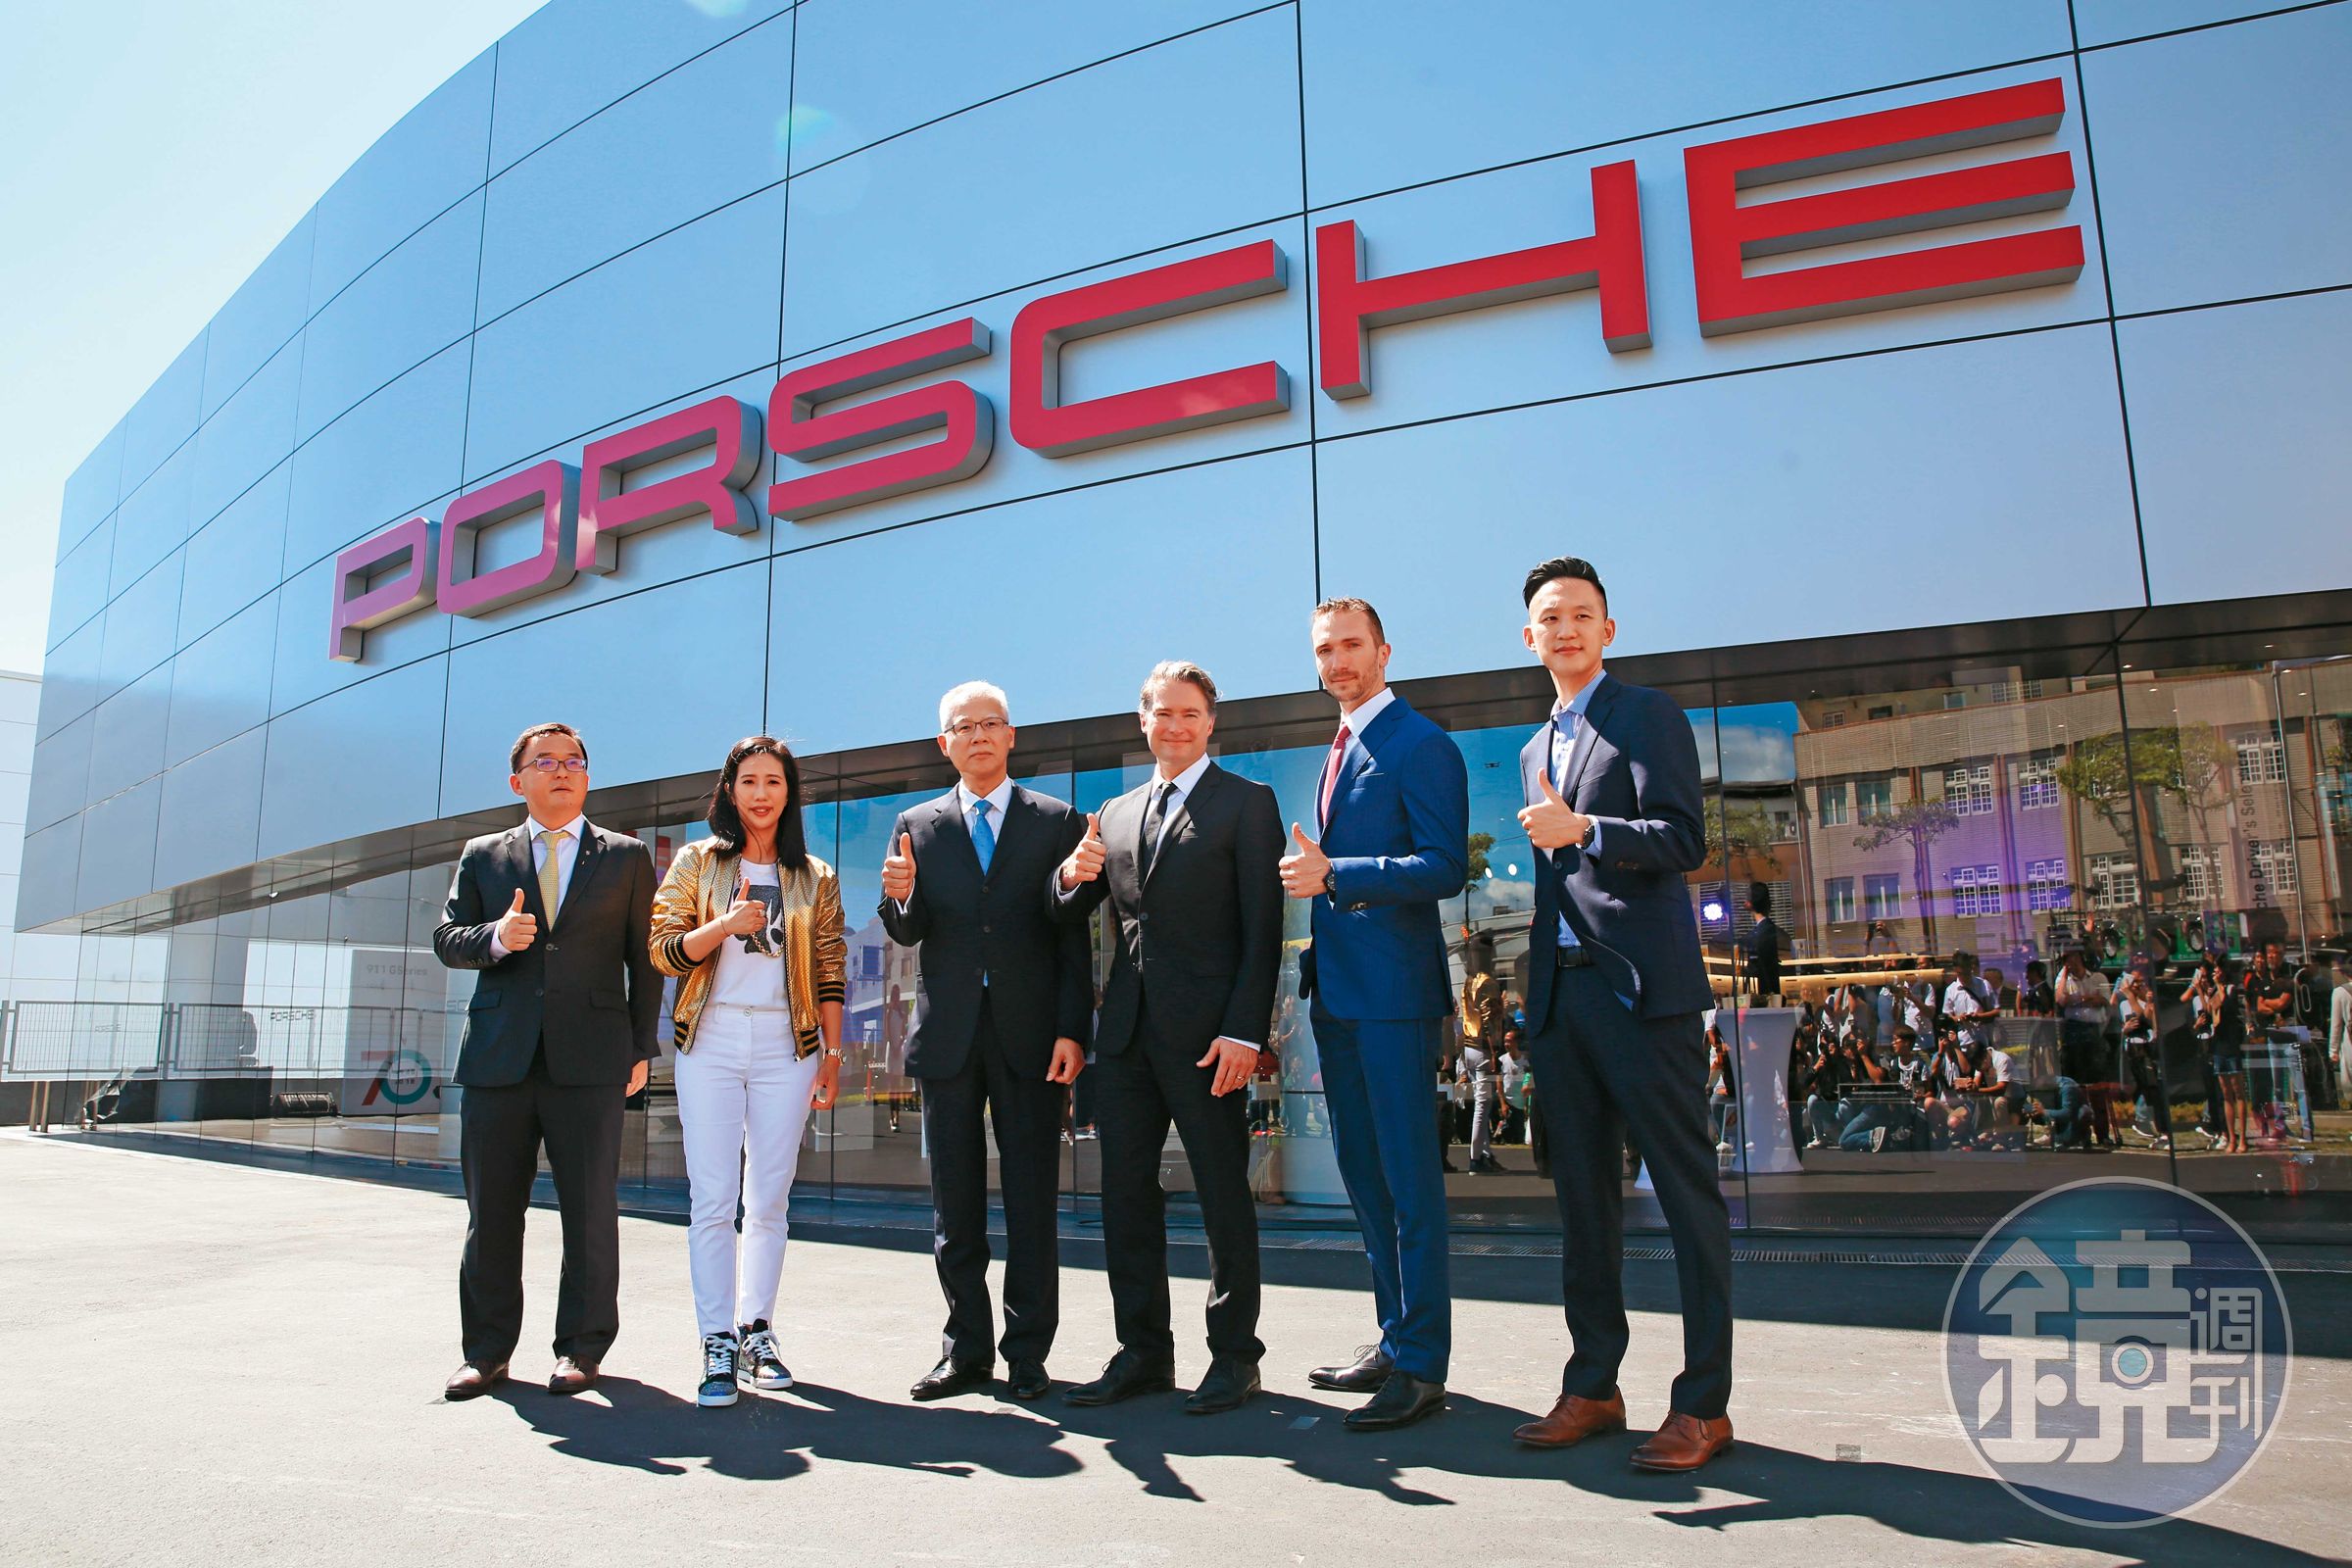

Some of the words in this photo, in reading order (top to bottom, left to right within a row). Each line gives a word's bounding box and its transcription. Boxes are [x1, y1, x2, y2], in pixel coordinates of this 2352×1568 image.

[329, 77, 2084, 662] PORSCHE
[2242, 822, 2266, 879] Driver's
[367, 963, 386, 974] 911
[270, 1009, 315, 1021] PORSCHE
[361, 1050, 432, 1105] 70
